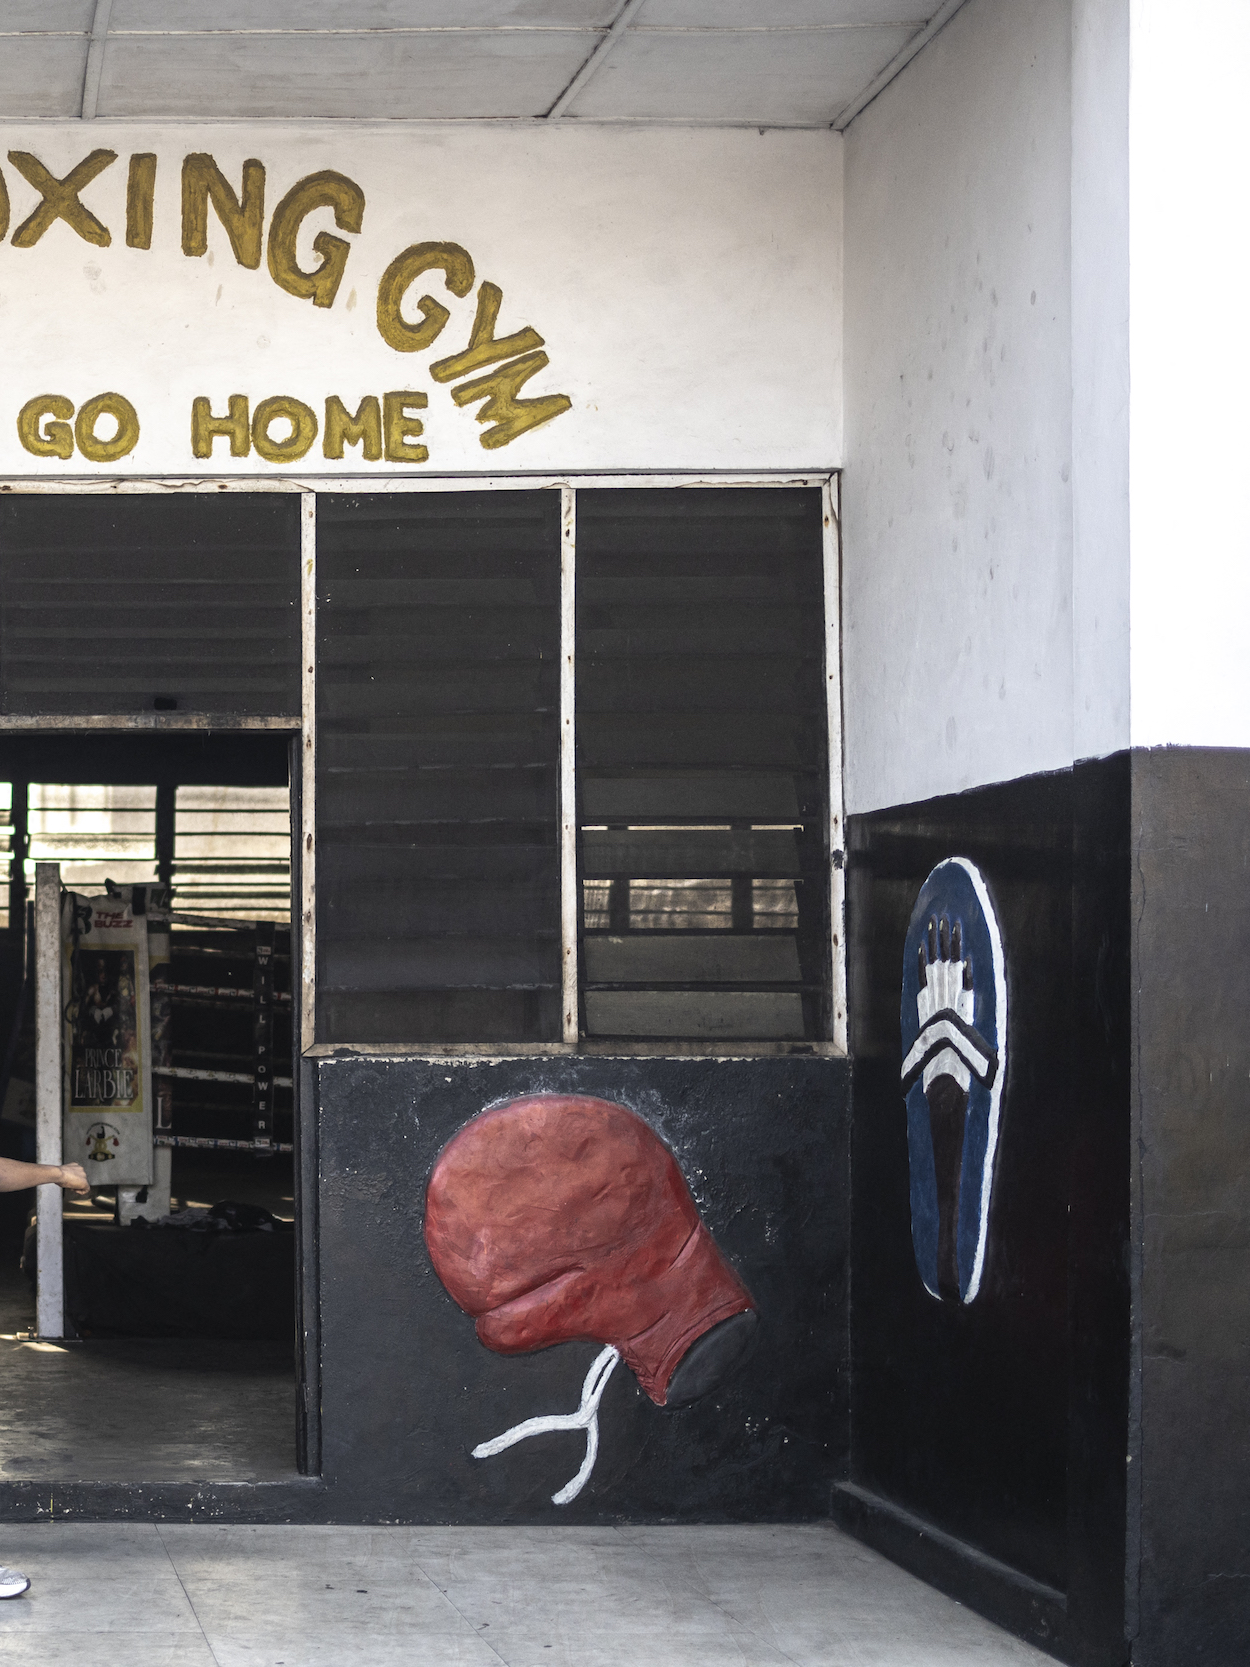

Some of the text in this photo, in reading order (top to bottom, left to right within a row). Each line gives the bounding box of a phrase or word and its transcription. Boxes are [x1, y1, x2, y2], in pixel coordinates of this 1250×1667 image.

[376, 241, 573, 451] GYM
[16, 391, 141, 463] GO
[190, 390, 430, 464] HOME
[94, 919, 134, 929] BUZZ
[95, 911, 124, 920] THE
[257, 956, 269, 1024] WILL
[85, 1048, 122, 1069] PRINCE
[74, 1069, 134, 1102] LARBIE
[257, 1045, 269, 1130] POWER
